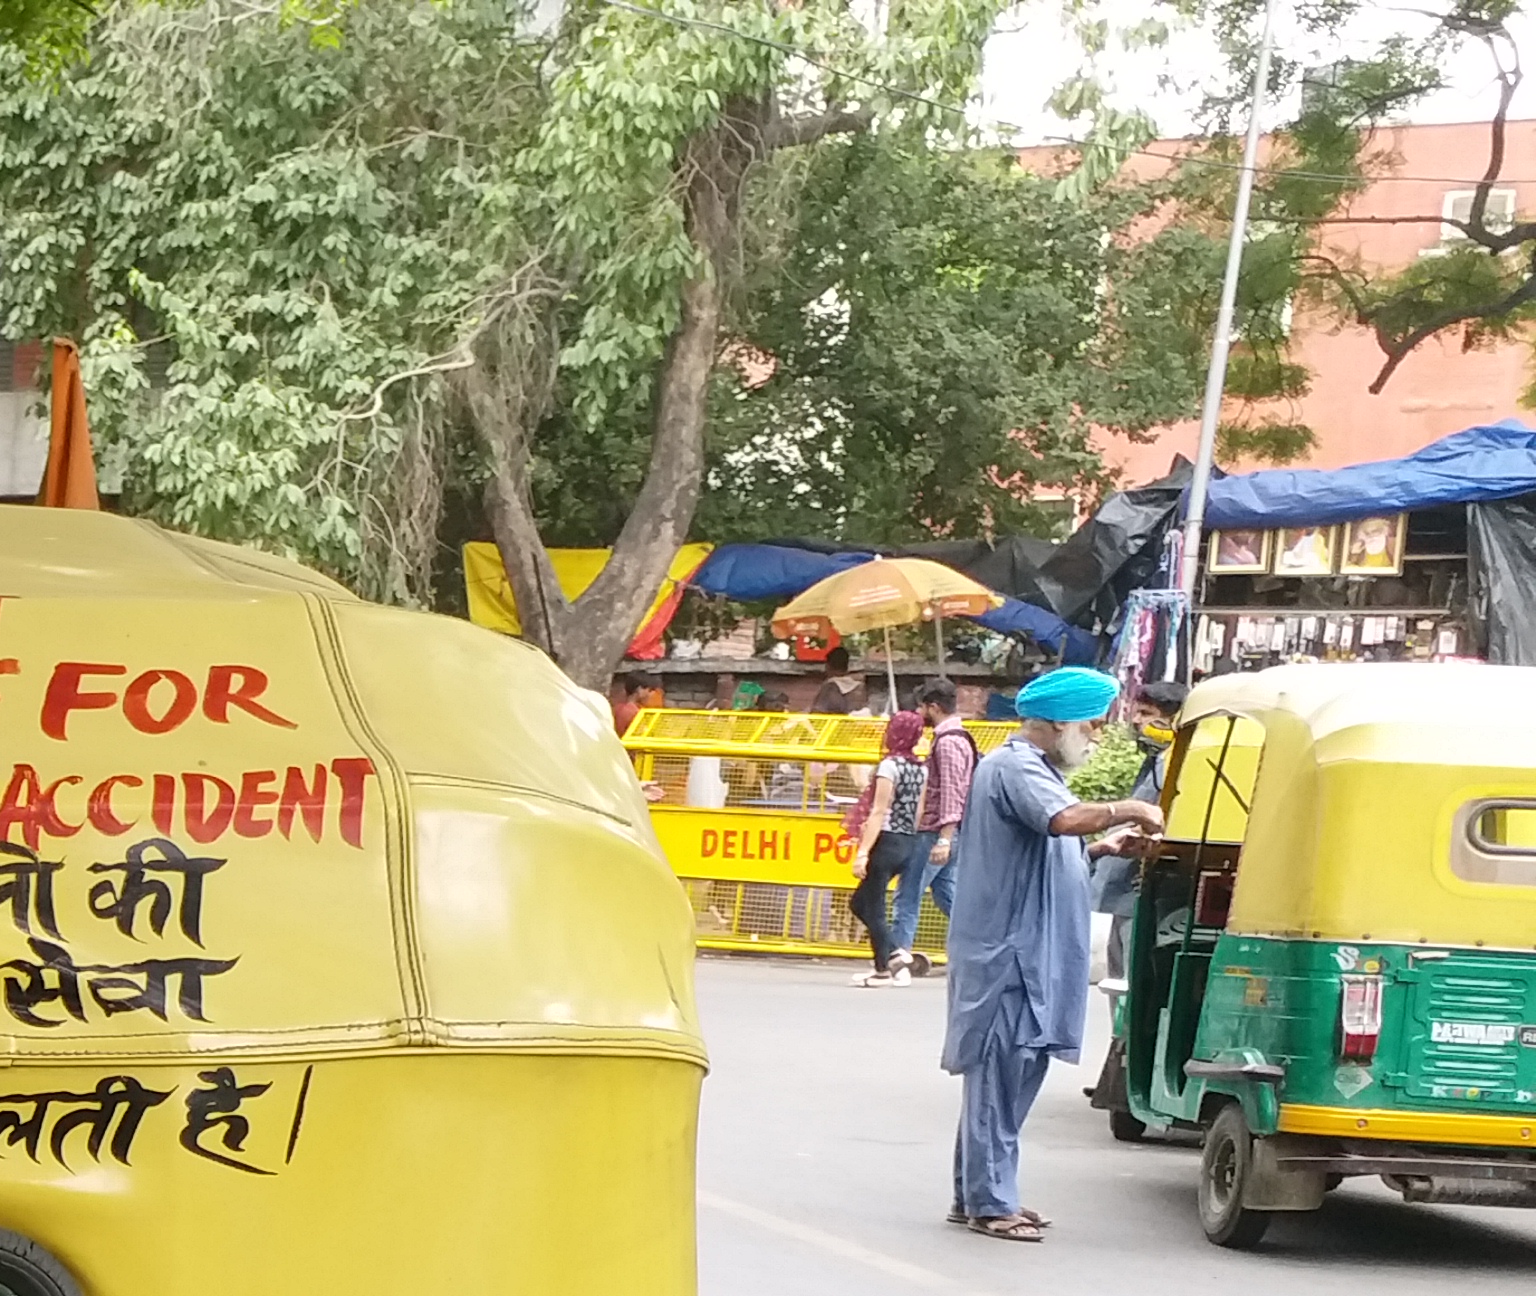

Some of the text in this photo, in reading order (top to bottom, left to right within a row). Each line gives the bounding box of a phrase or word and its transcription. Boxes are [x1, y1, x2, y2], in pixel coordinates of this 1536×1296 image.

[40, 660, 299, 741] FOR
[701, 829, 791, 861] DELHI
[87, 837, 228, 950] की
